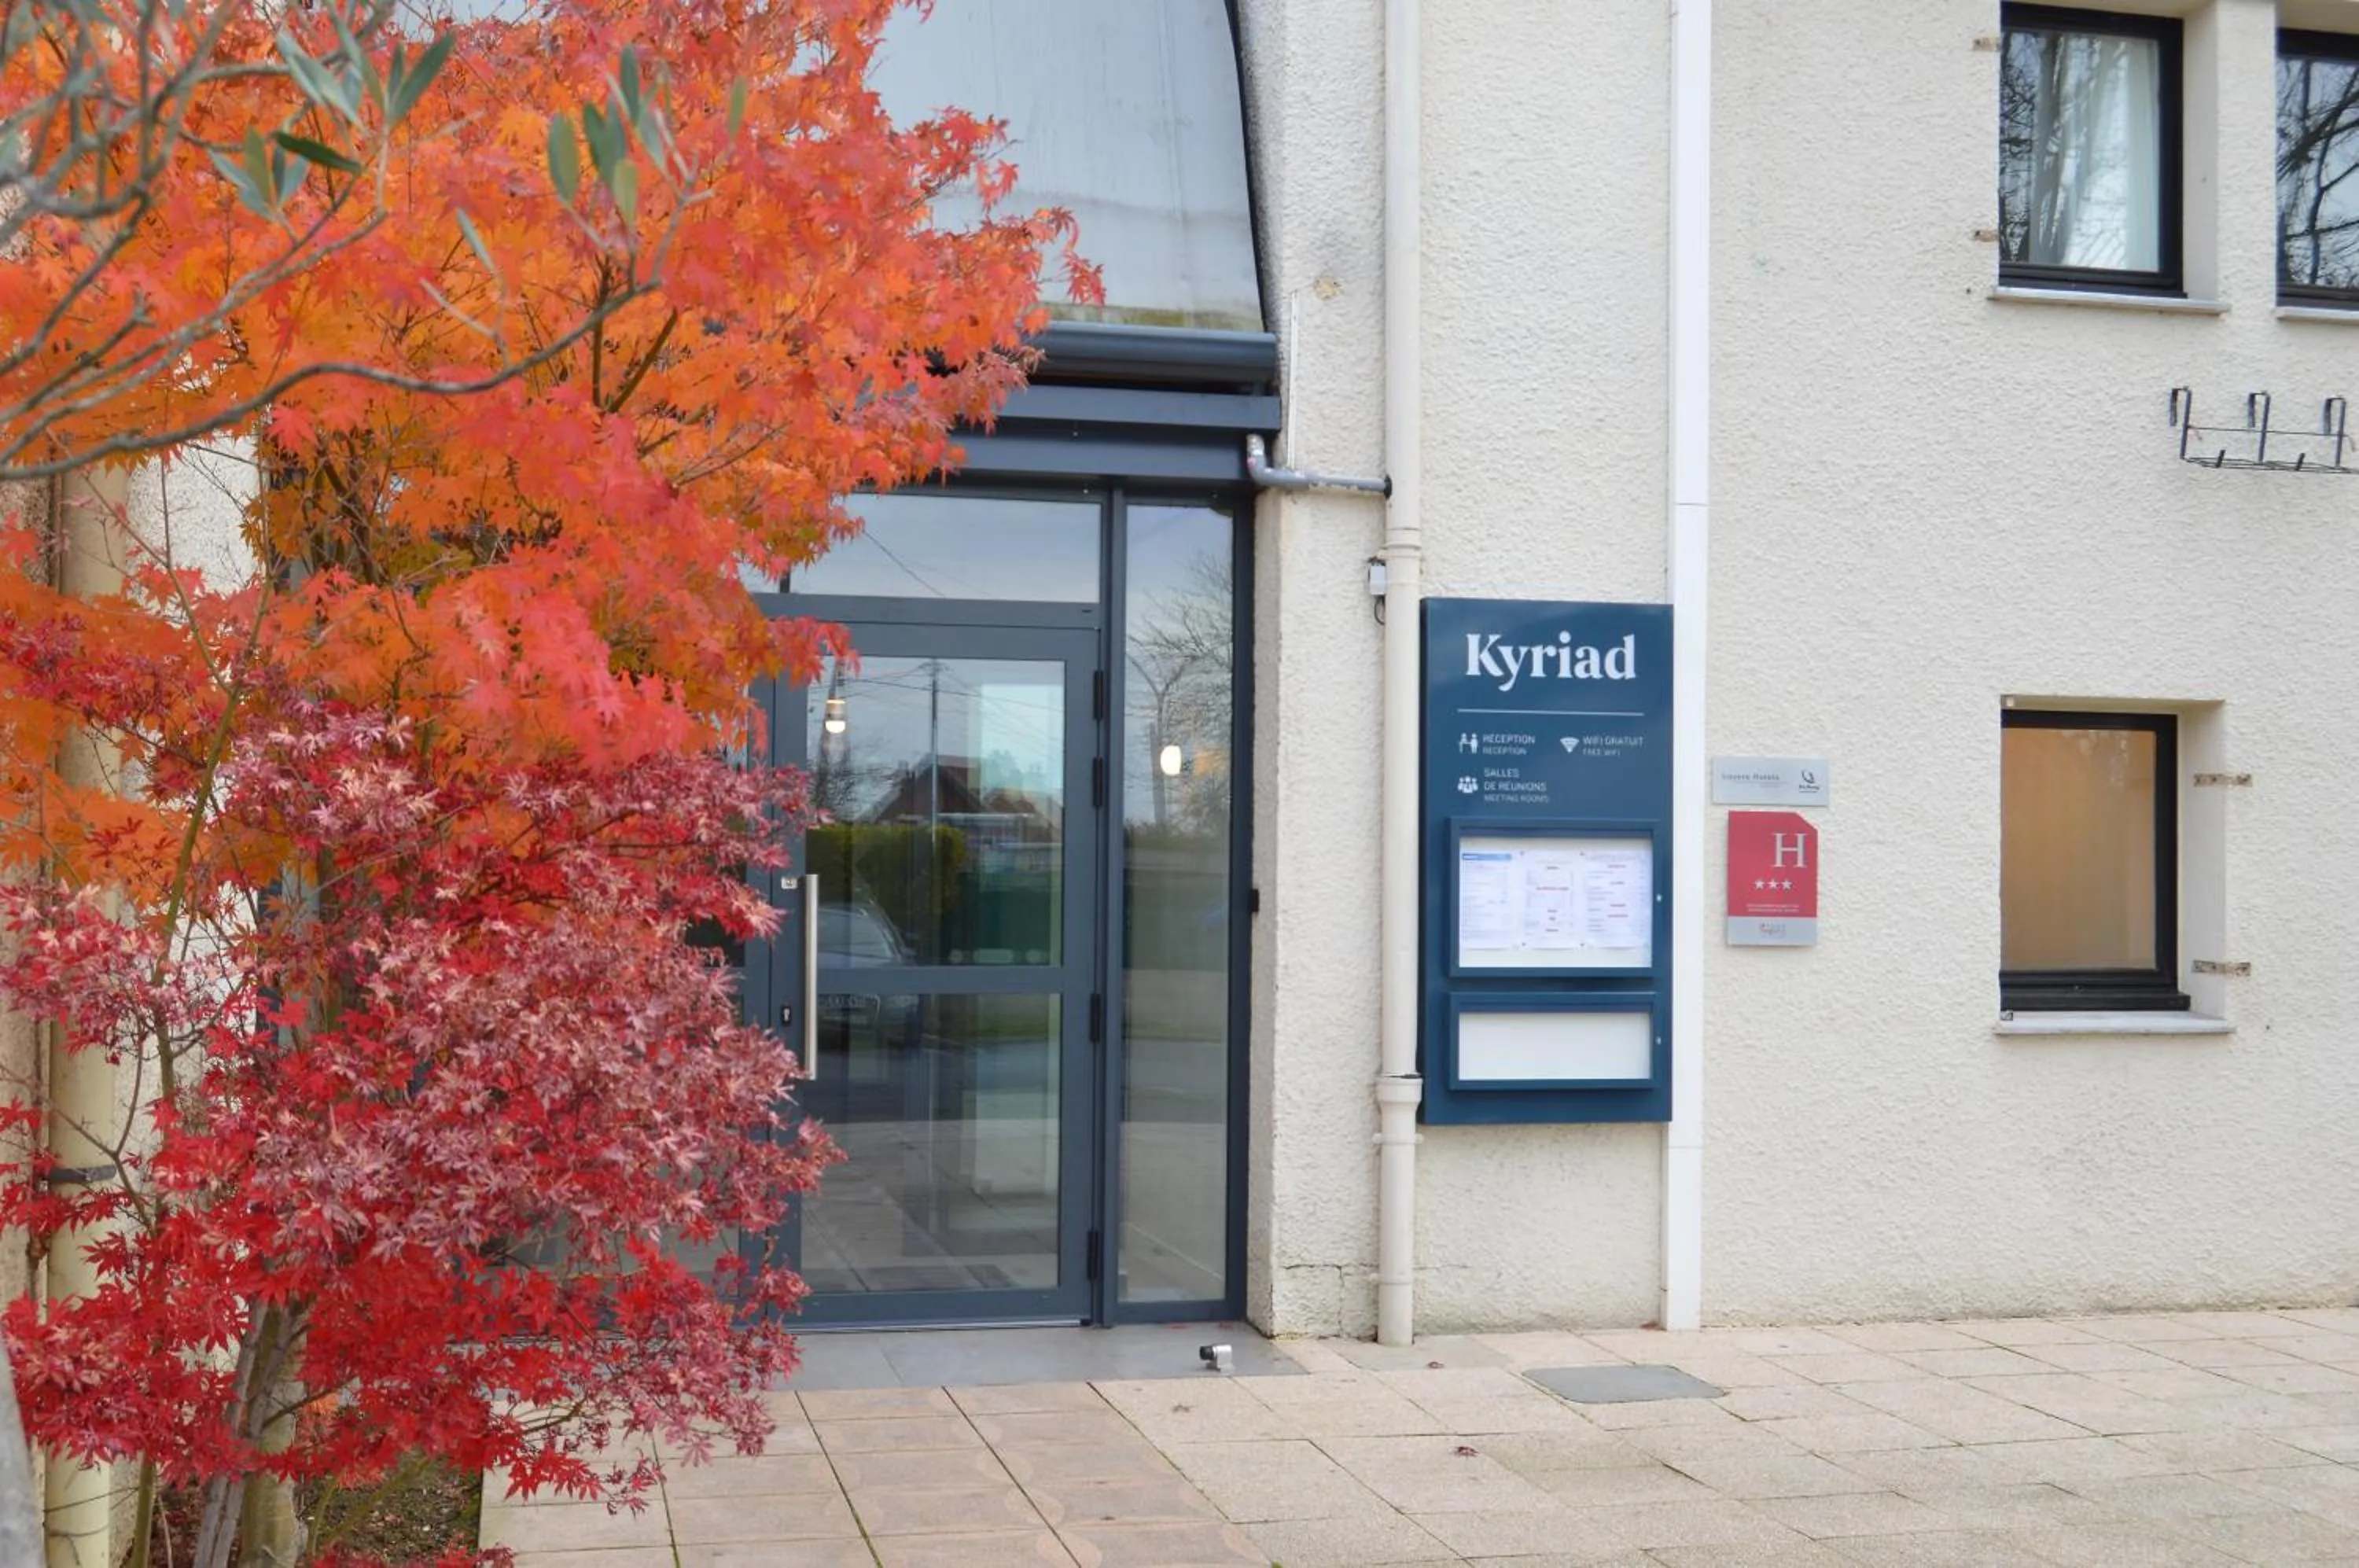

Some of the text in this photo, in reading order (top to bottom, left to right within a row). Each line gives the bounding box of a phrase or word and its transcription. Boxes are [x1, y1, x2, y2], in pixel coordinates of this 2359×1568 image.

[1465, 631, 1636, 692] Kyriad
[1484, 767, 1520, 778] SALLES
[1484, 780, 1496, 791] DE
[1772, 832, 1808, 868] H
